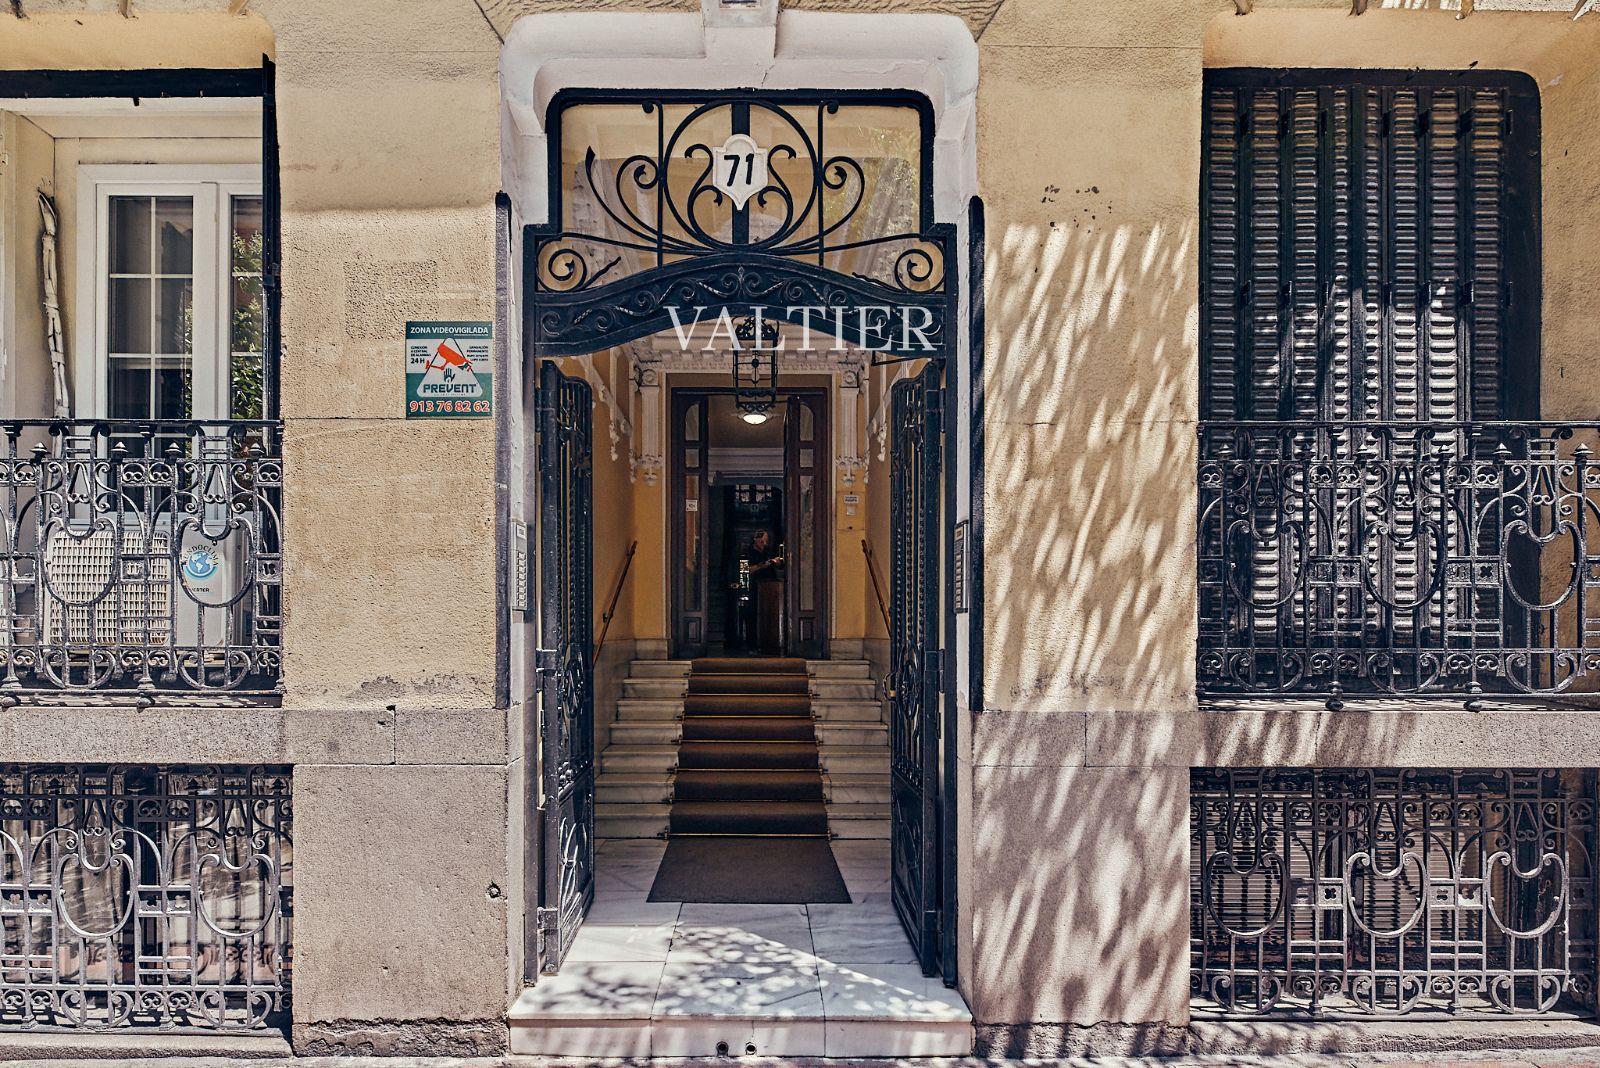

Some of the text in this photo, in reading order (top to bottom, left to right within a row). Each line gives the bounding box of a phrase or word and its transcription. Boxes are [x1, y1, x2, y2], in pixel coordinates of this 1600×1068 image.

[724, 153, 755, 187] 71
[423, 384, 477, 393] PREVENT
[409, 400, 491, 413] 913 76 82 62
[183, 544, 219, 566] UNDOCLIMA
